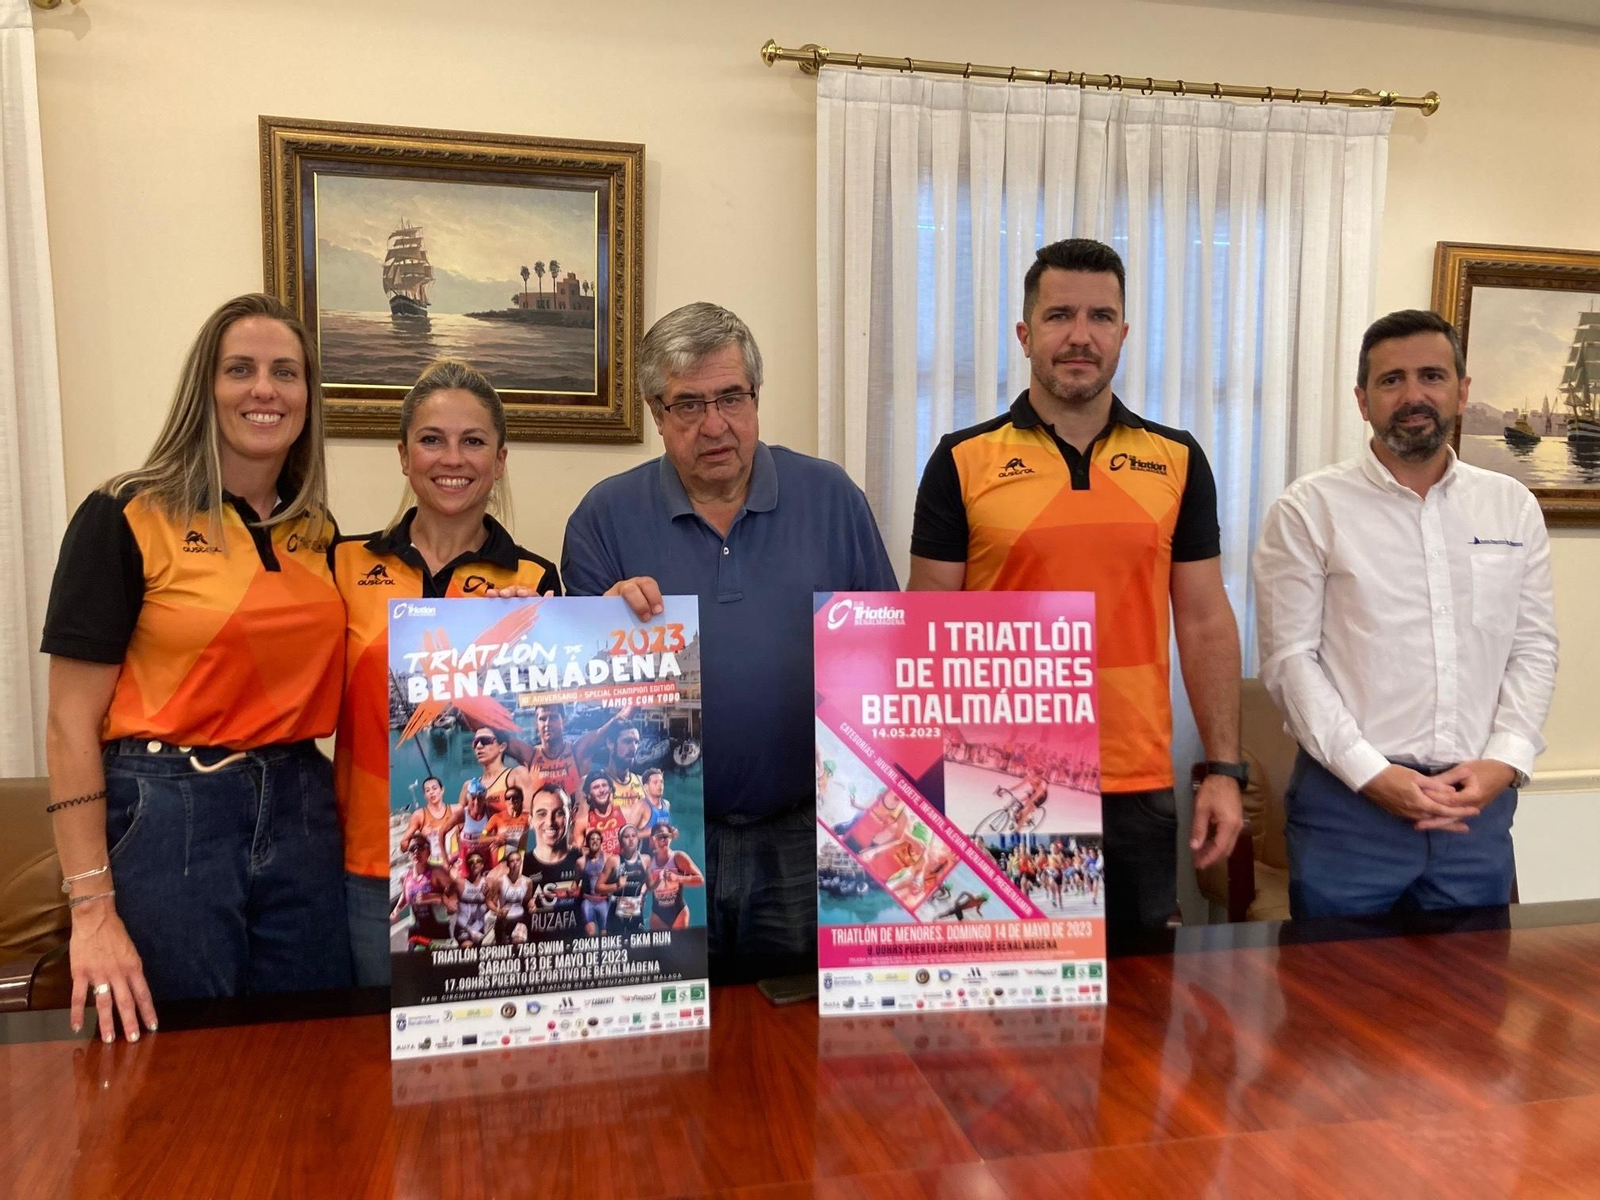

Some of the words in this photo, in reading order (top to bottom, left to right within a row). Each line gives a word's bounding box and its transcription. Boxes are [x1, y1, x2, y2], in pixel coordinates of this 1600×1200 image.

[853, 606, 905, 619] Triatlón
[609, 622, 686, 657] 2023
[928, 621, 936, 652] I
[944, 616, 1092, 652] TRIATLÓN
[403, 635, 557, 674] TRIATLÓN
[407, 652, 682, 703] BENALMÁDENA
[896, 657, 934, 688] DE
[943, 656, 1093, 688] MENORES
[533, 691, 578, 702] ANIVERSARIO
[584, 688, 611, 698] SPECIAL
[613, 684, 648, 696] CHAMPION
[650, 682, 675, 692] EDITION
[602, 697, 633, 708] VAMOS
[636, 695, 656, 704] CON
[657, 692, 680, 702] TODO
[861, 687, 1095, 724] BENALMÁDENA
[838, 721, 874, 757] CATEGORÍAS
[871, 727, 941, 738] 14.05.2023
[531, 910, 577, 930] RUZAFA
[831, 925, 878, 946] TRIATLÓN
[880, 926, 892, 943] DE
[946, 923, 991, 941] DOMINGO
[994, 923, 1006, 939] 14
[1008, 922, 1020, 939] DE
[1022, 921, 1050, 939] MAYO
[1052, 921, 1064, 938] DE
[1066, 920, 1093, 938] 2023
[432, 946, 478, 965] TRIATLÓN
[518, 942, 536, 957] 750
[538, 939, 564, 955] SWIM
[572, 937, 599, 952] 20KM
[601, 935, 622, 949] BIKE
[630, 932, 650, 947] 5KM
[652, 931, 671, 945] RUN
[905, 942, 936, 955] PUERTO
[938, 941, 983, 954] DEPORTIVO
[984, 940, 994, 952] DE
[478, 957, 521, 976] SÁBADO
[524, 957, 537, 972] 13
[539, 954, 552, 970] DE
[555, 952, 583, 968] MAYO
[586, 951, 599, 966] DE
[601, 949, 628, 964] 2023
[492, 971, 527, 988] PUERTO
[529, 967, 579, 984] DEPORTIVO
[581, 966, 592, 980] DE
[594, 960, 660, 978] BENALMÁDENA
